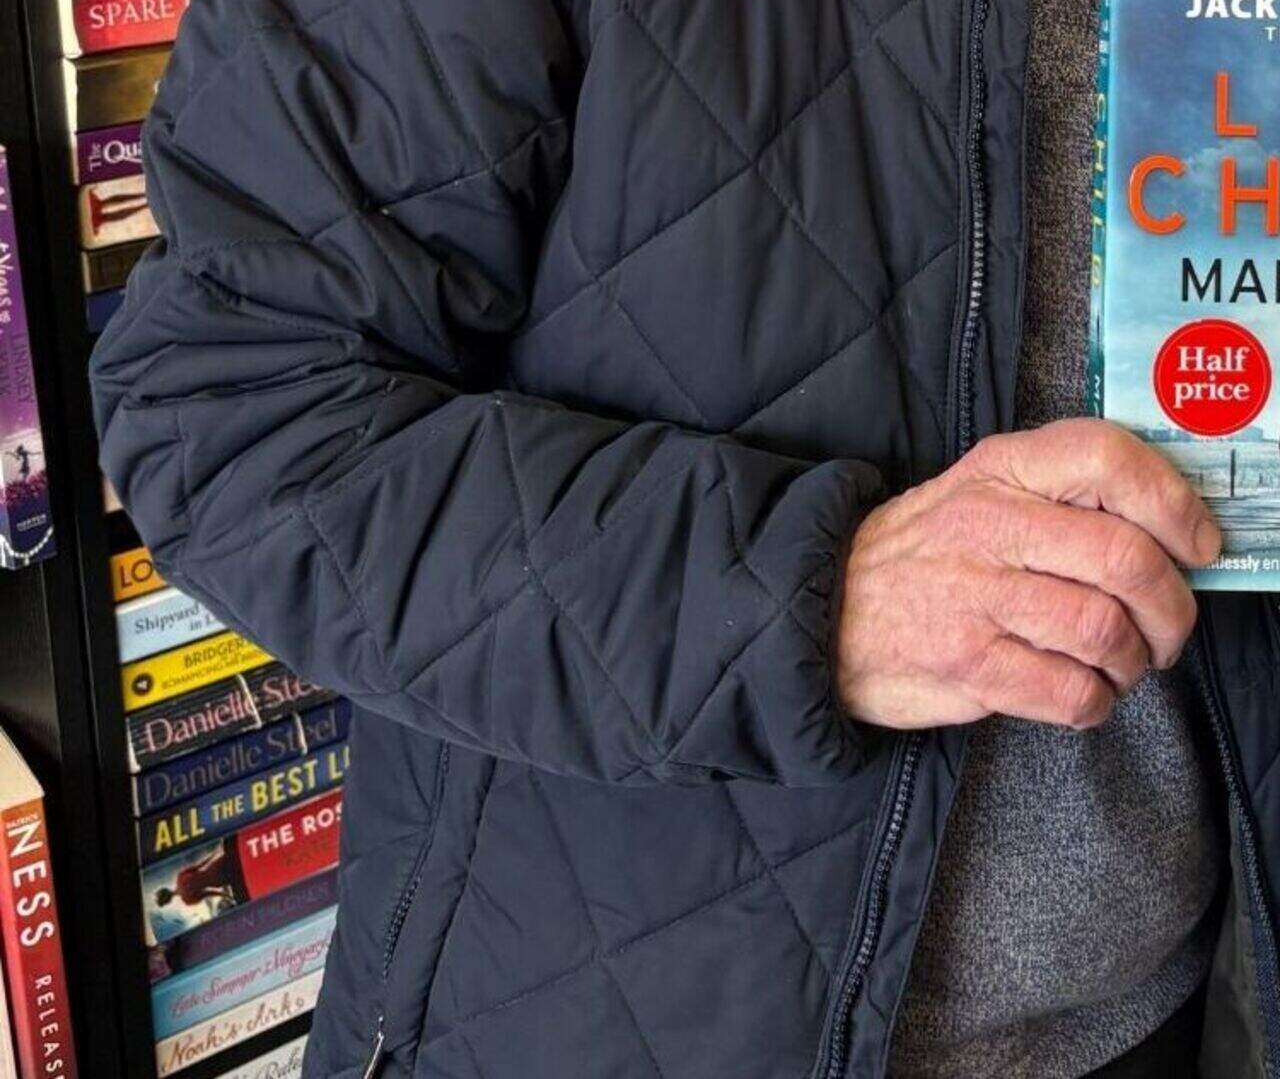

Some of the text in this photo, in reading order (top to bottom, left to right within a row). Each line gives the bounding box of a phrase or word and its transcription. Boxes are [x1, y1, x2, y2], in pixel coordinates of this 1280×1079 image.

[88, 0, 176, 30] SPARE
[1177, 346, 1251, 372] Half
[1174, 376, 1251, 408] price
[155, 759, 318, 852] ALL THE BEST
